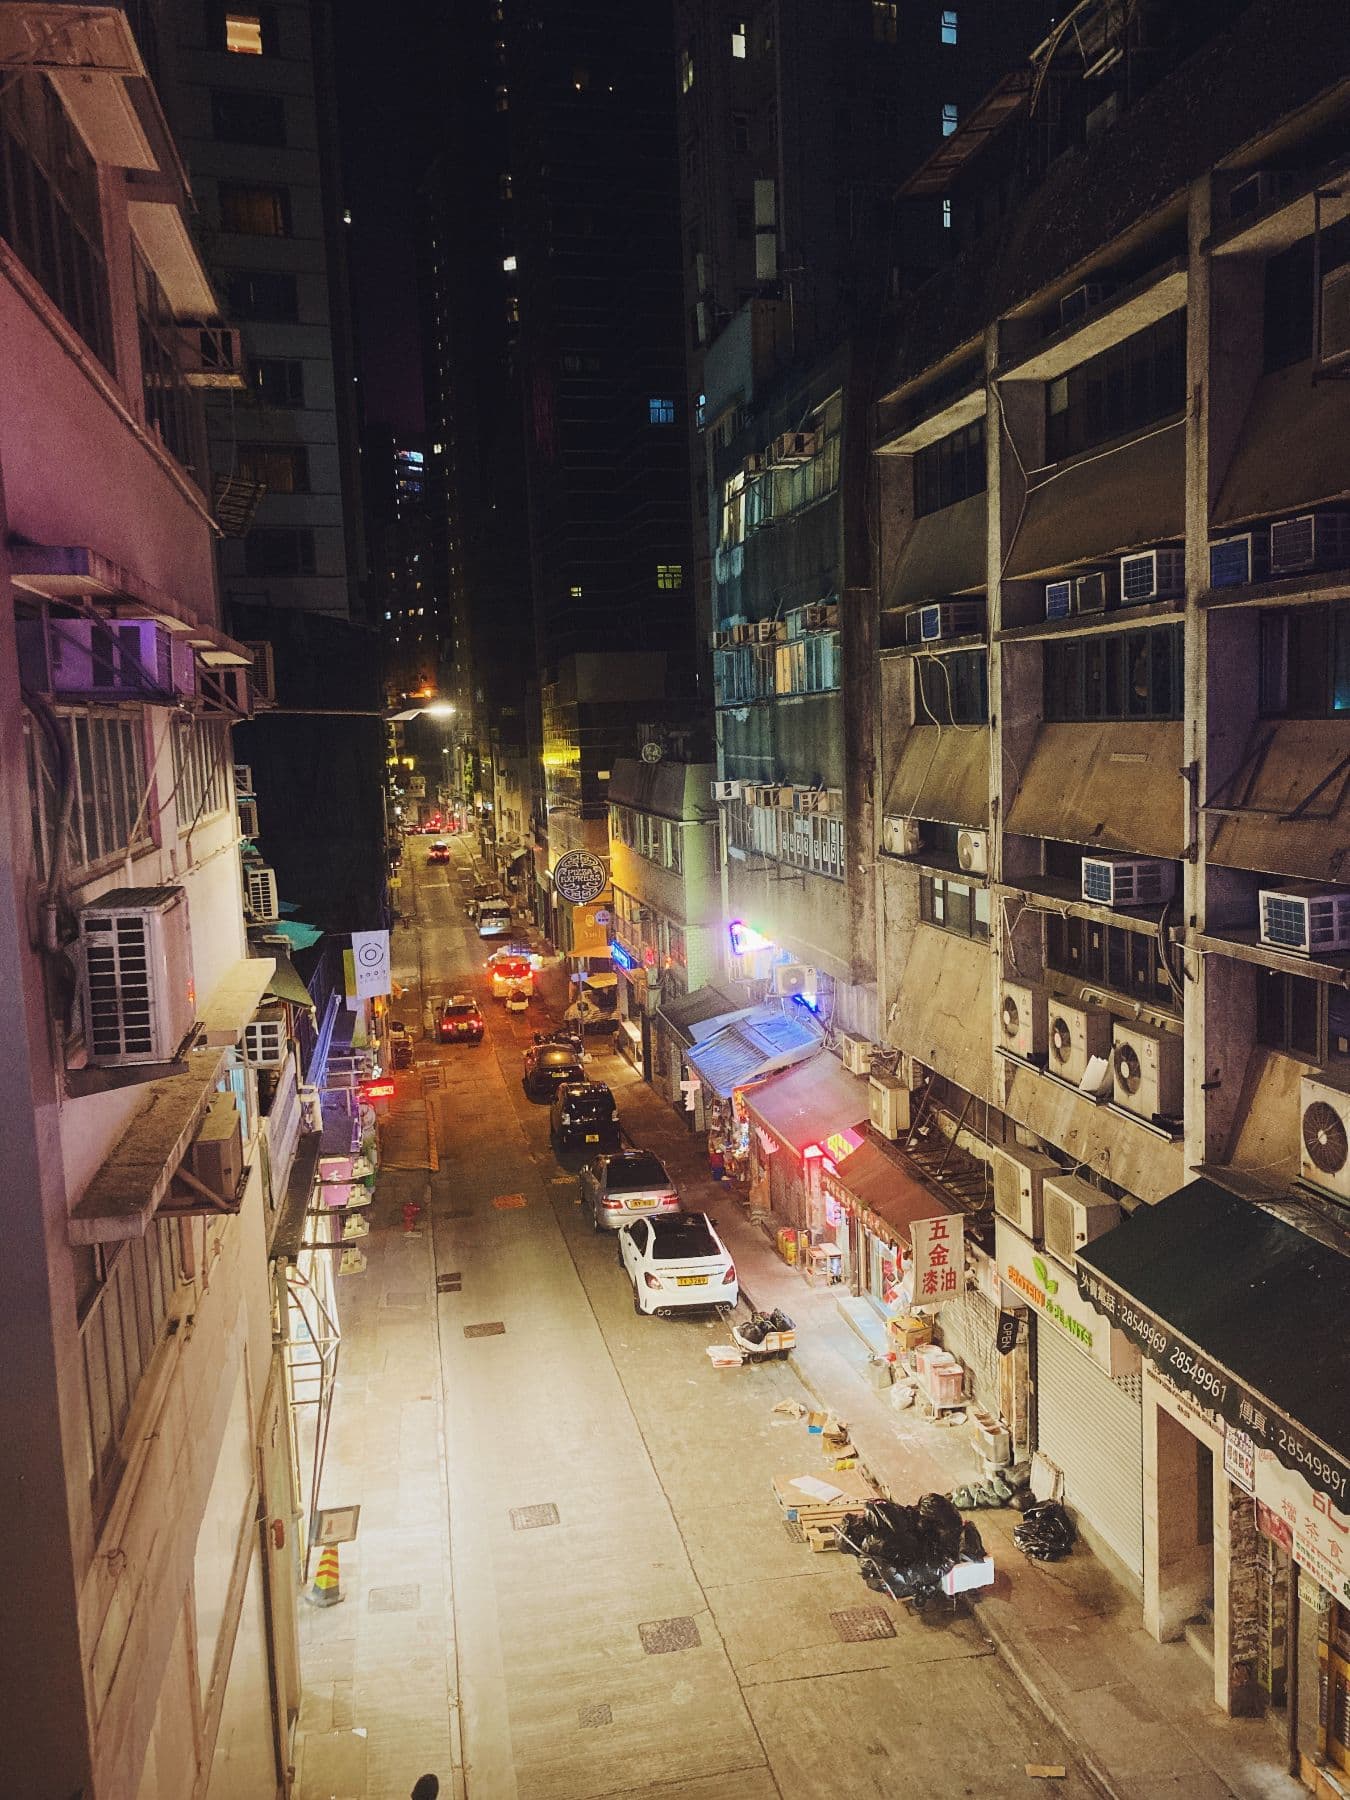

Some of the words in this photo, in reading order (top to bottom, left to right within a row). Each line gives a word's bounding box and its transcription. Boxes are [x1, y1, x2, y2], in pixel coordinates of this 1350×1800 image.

[560, 874, 601, 883] EXPRESS
[567, 868, 593, 876] PIZZA
[928, 1218, 950, 1268] 五金
[1002, 1321, 1014, 1349] OPEN
[1121, 1305, 1168, 1353] 28549969
[1169, 1346, 1227, 1403] 28549961
[1278, 1429, 1346, 1498] 28549891
